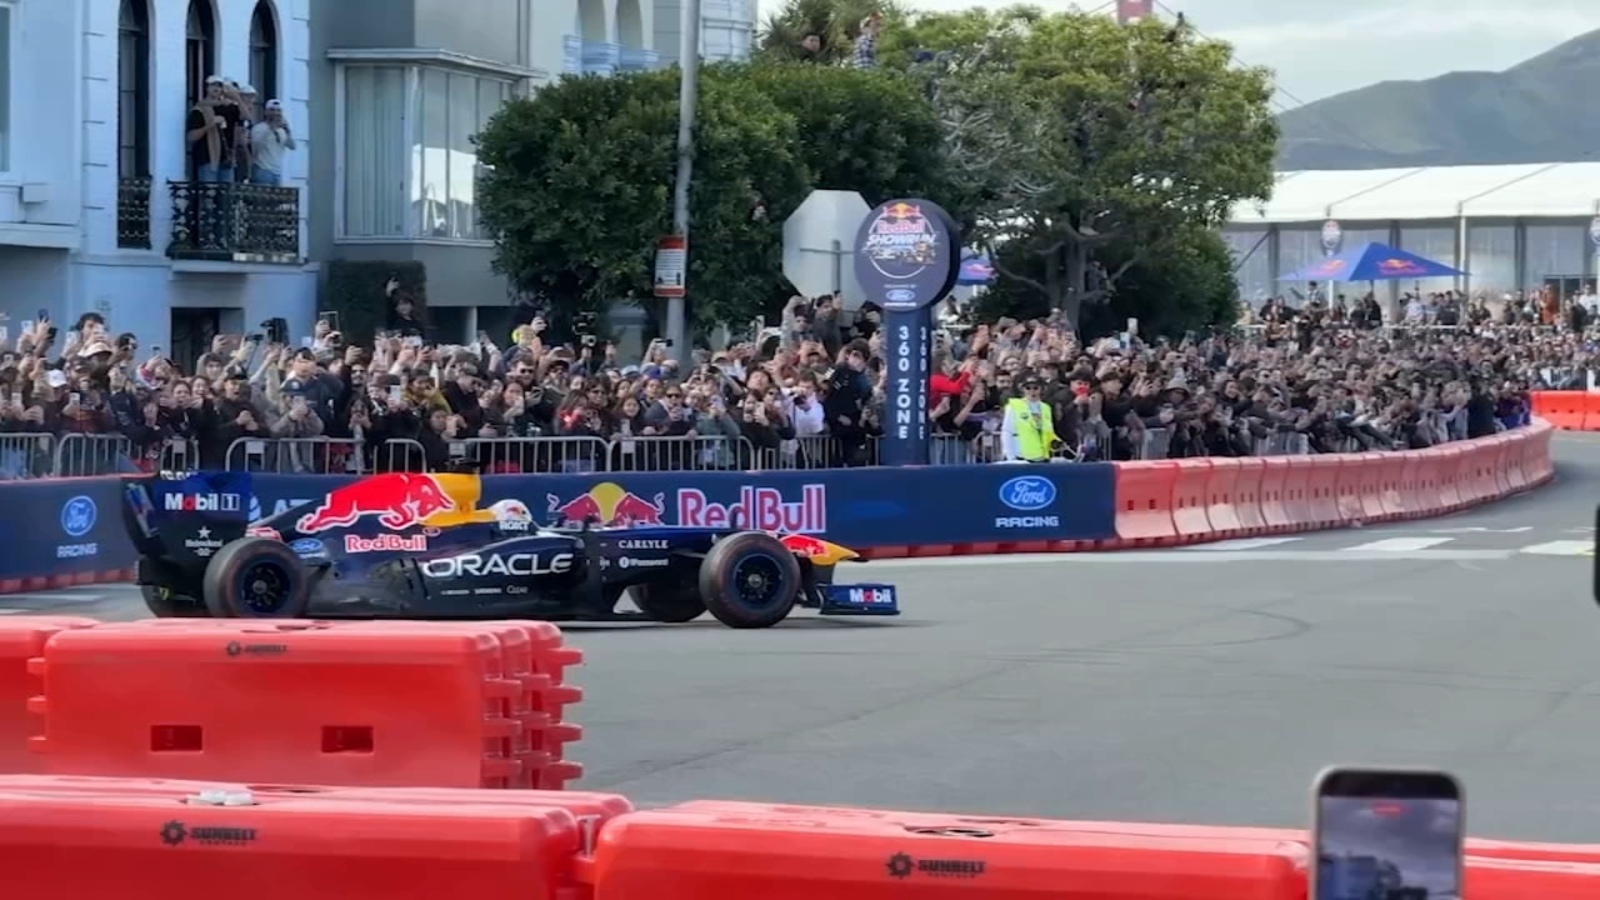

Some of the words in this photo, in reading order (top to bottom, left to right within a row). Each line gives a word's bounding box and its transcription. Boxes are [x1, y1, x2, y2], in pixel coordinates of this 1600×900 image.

[898, 326, 910, 372] 360
[896, 378, 911, 439] ZONE
[164, 492, 218, 511] Mobil
[995, 516, 1060, 528] RACING
[57, 542, 97, 558] RACING
[618, 539, 669, 549] CARLYLE
[423, 553, 574, 578] ORACLE
[849, 588, 892, 603] Mobil
[190, 826, 256, 841] SUNBELT
[917, 859, 986, 873] SUNBELT
